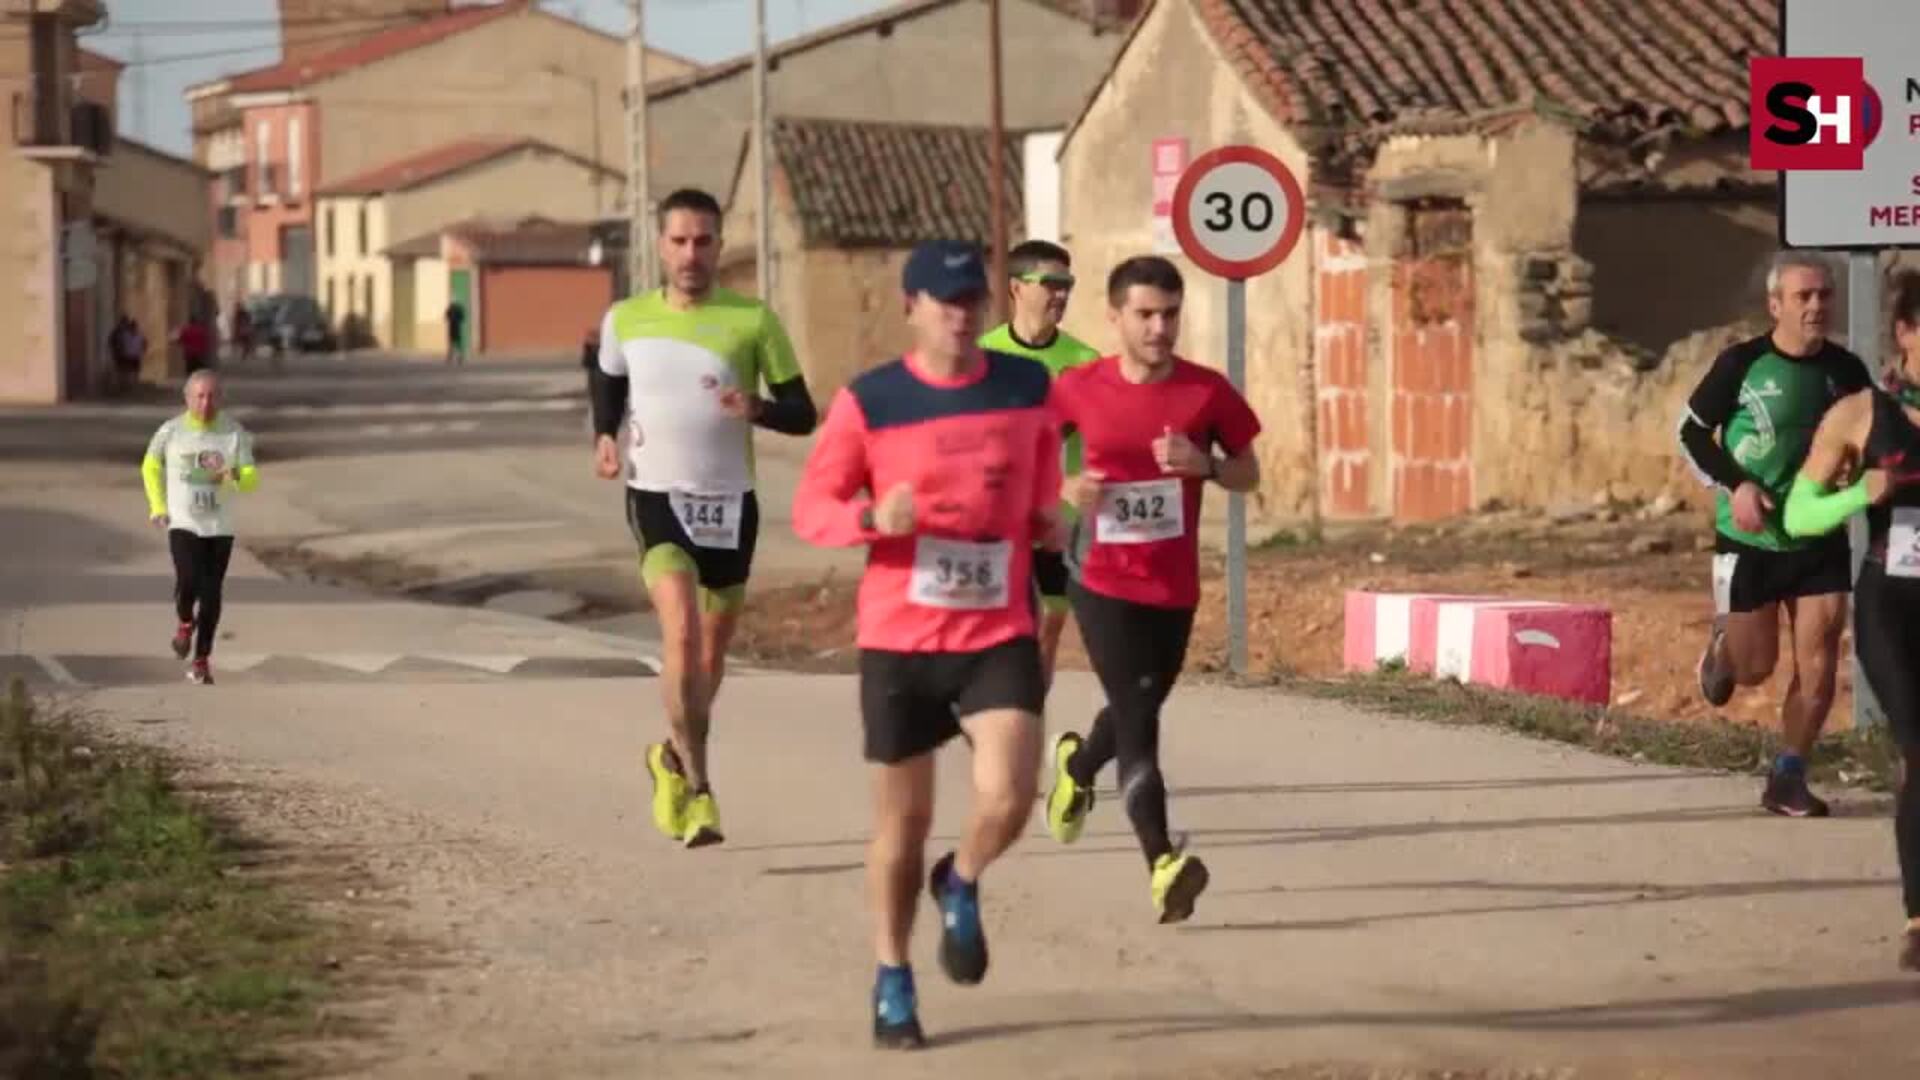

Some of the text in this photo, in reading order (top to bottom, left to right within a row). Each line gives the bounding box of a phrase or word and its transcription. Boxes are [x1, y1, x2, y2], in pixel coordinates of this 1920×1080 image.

[1204, 192, 1274, 232] 30
[683, 502, 724, 527] 344
[1115, 495, 1165, 522] 342
[936, 556, 993, 587] 356
